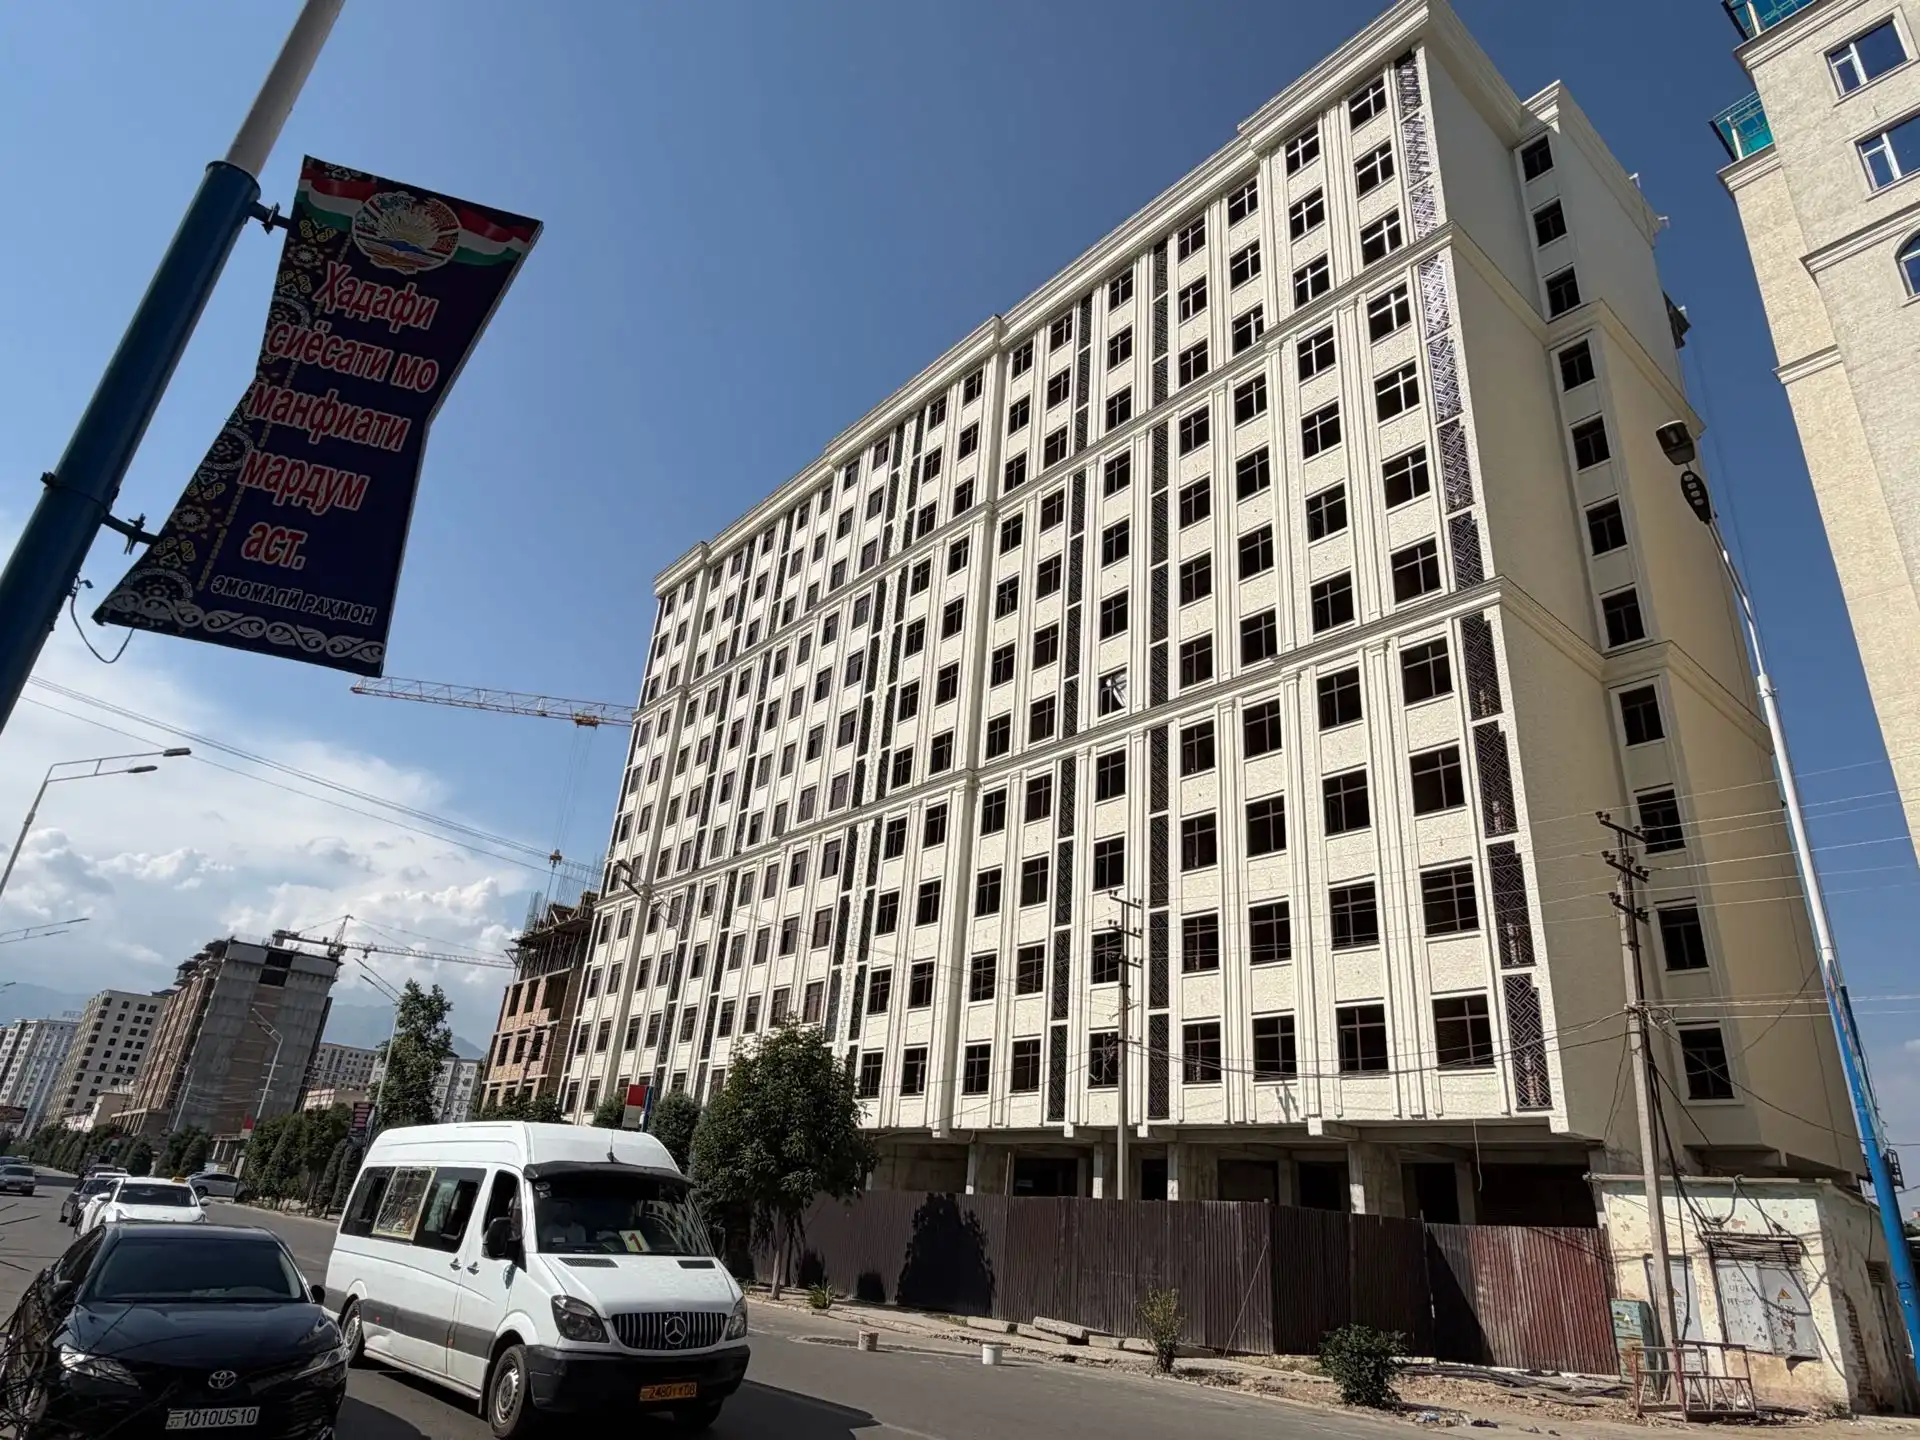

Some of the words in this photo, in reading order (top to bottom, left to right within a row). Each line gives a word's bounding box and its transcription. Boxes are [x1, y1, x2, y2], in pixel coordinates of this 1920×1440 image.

[266, 320, 394, 382] сиёсати
[390, 352, 440, 394] мо
[248, 381, 412, 453] манфиати
[237, 448, 371, 517] мардум
[240, 520, 308, 571] аст.
